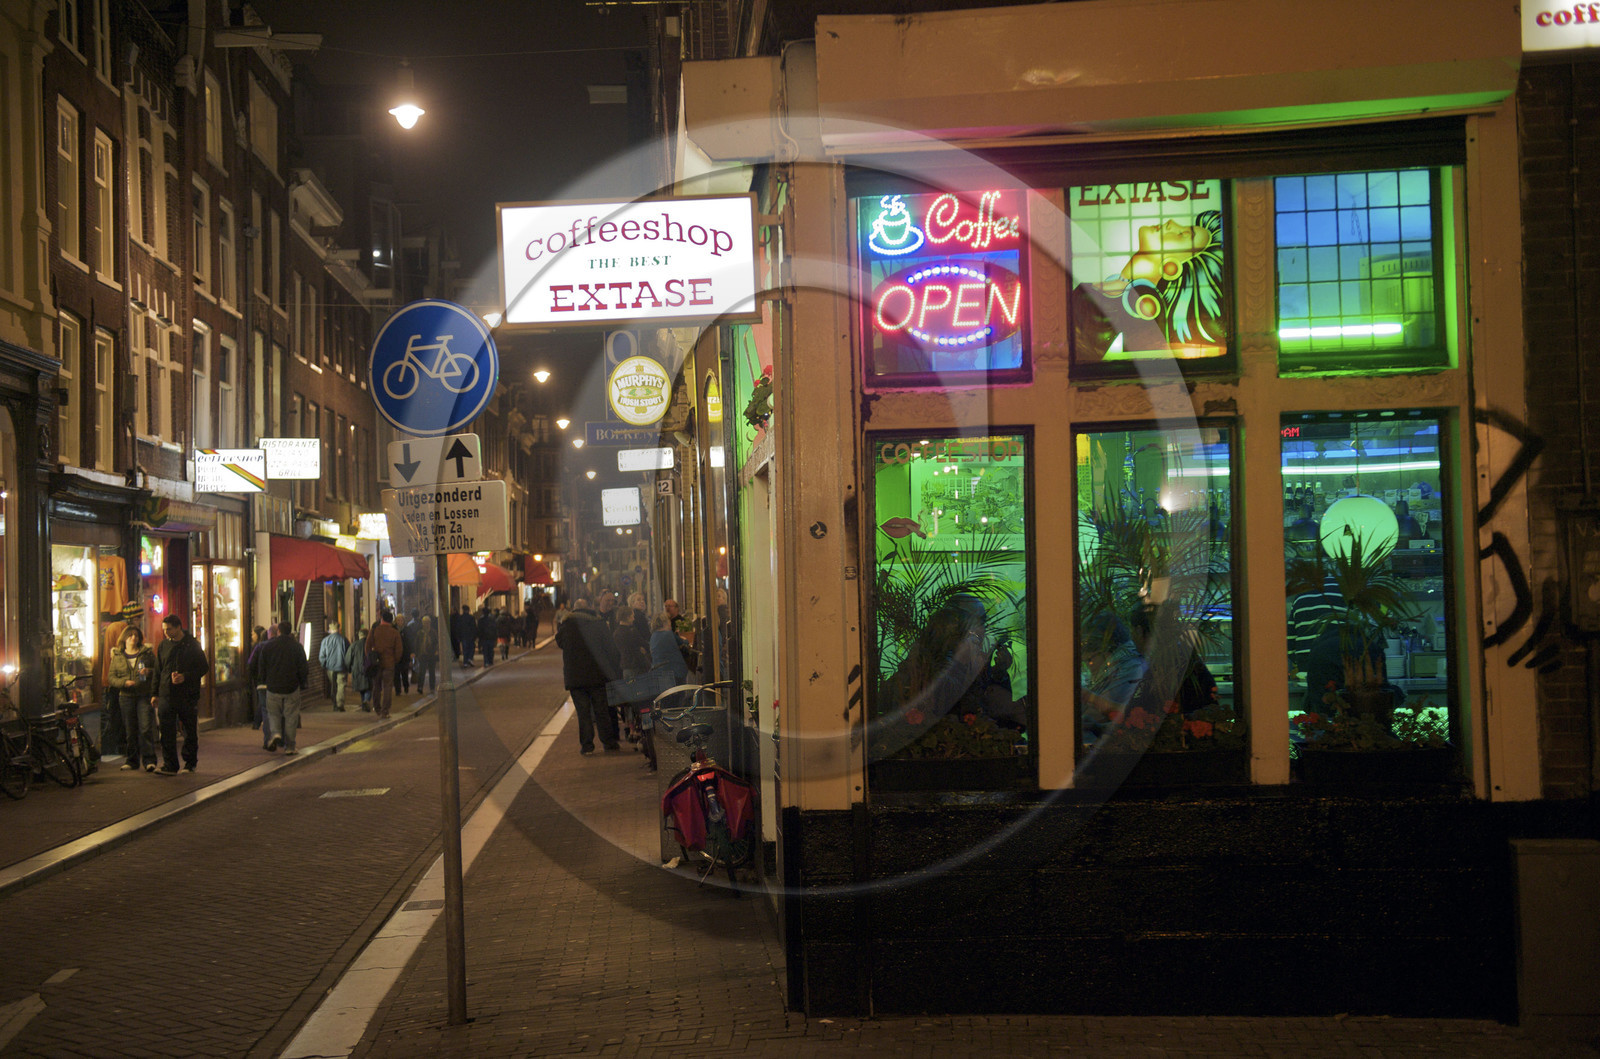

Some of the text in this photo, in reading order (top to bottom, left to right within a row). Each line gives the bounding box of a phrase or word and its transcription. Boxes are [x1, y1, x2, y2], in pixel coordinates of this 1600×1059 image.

[1536, 2, 1600, 27] coff
[1079, 180, 1210, 206] EXTASE
[525, 213, 733, 261] coffeeshop
[588, 255, 672, 269] THE BEST
[549, 278, 714, 312] EXTASE
[876, 282, 1021, 331] OPEN
[262, 440, 317, 448] RISTORANTE
[881, 441, 1021, 465] COFFEESHOP
[398, 486, 482, 509] Uitgezonderd
[658, 481, 670, 493] 12
[429, 511, 441, 521] en
[444, 508, 479, 520] Lossen
[431, 523, 447, 535] t/m
[450, 521, 462, 533] Za
